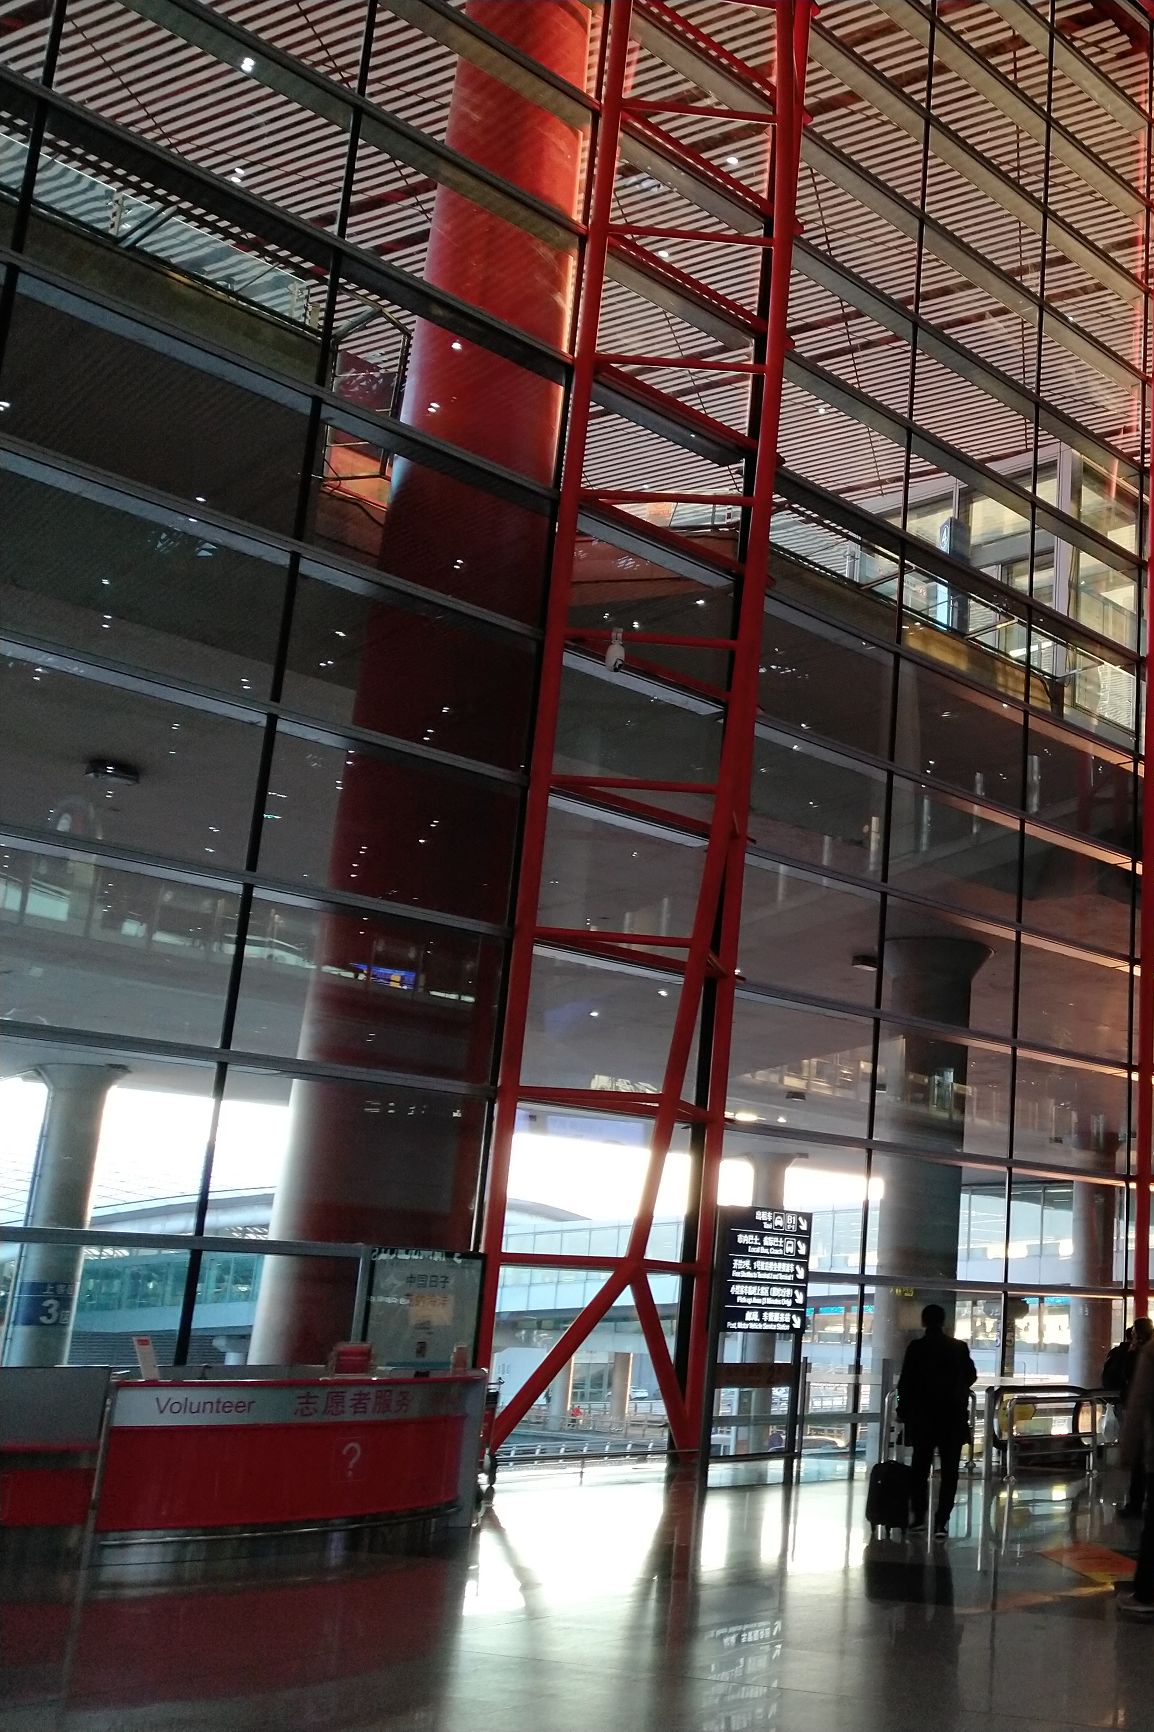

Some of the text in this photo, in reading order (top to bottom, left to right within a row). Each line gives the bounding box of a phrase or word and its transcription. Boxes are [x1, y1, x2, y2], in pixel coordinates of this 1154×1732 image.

[155, 1397, 256, 1414] Volunteer
[294, 1389, 413, 1417] 志愿者服务
